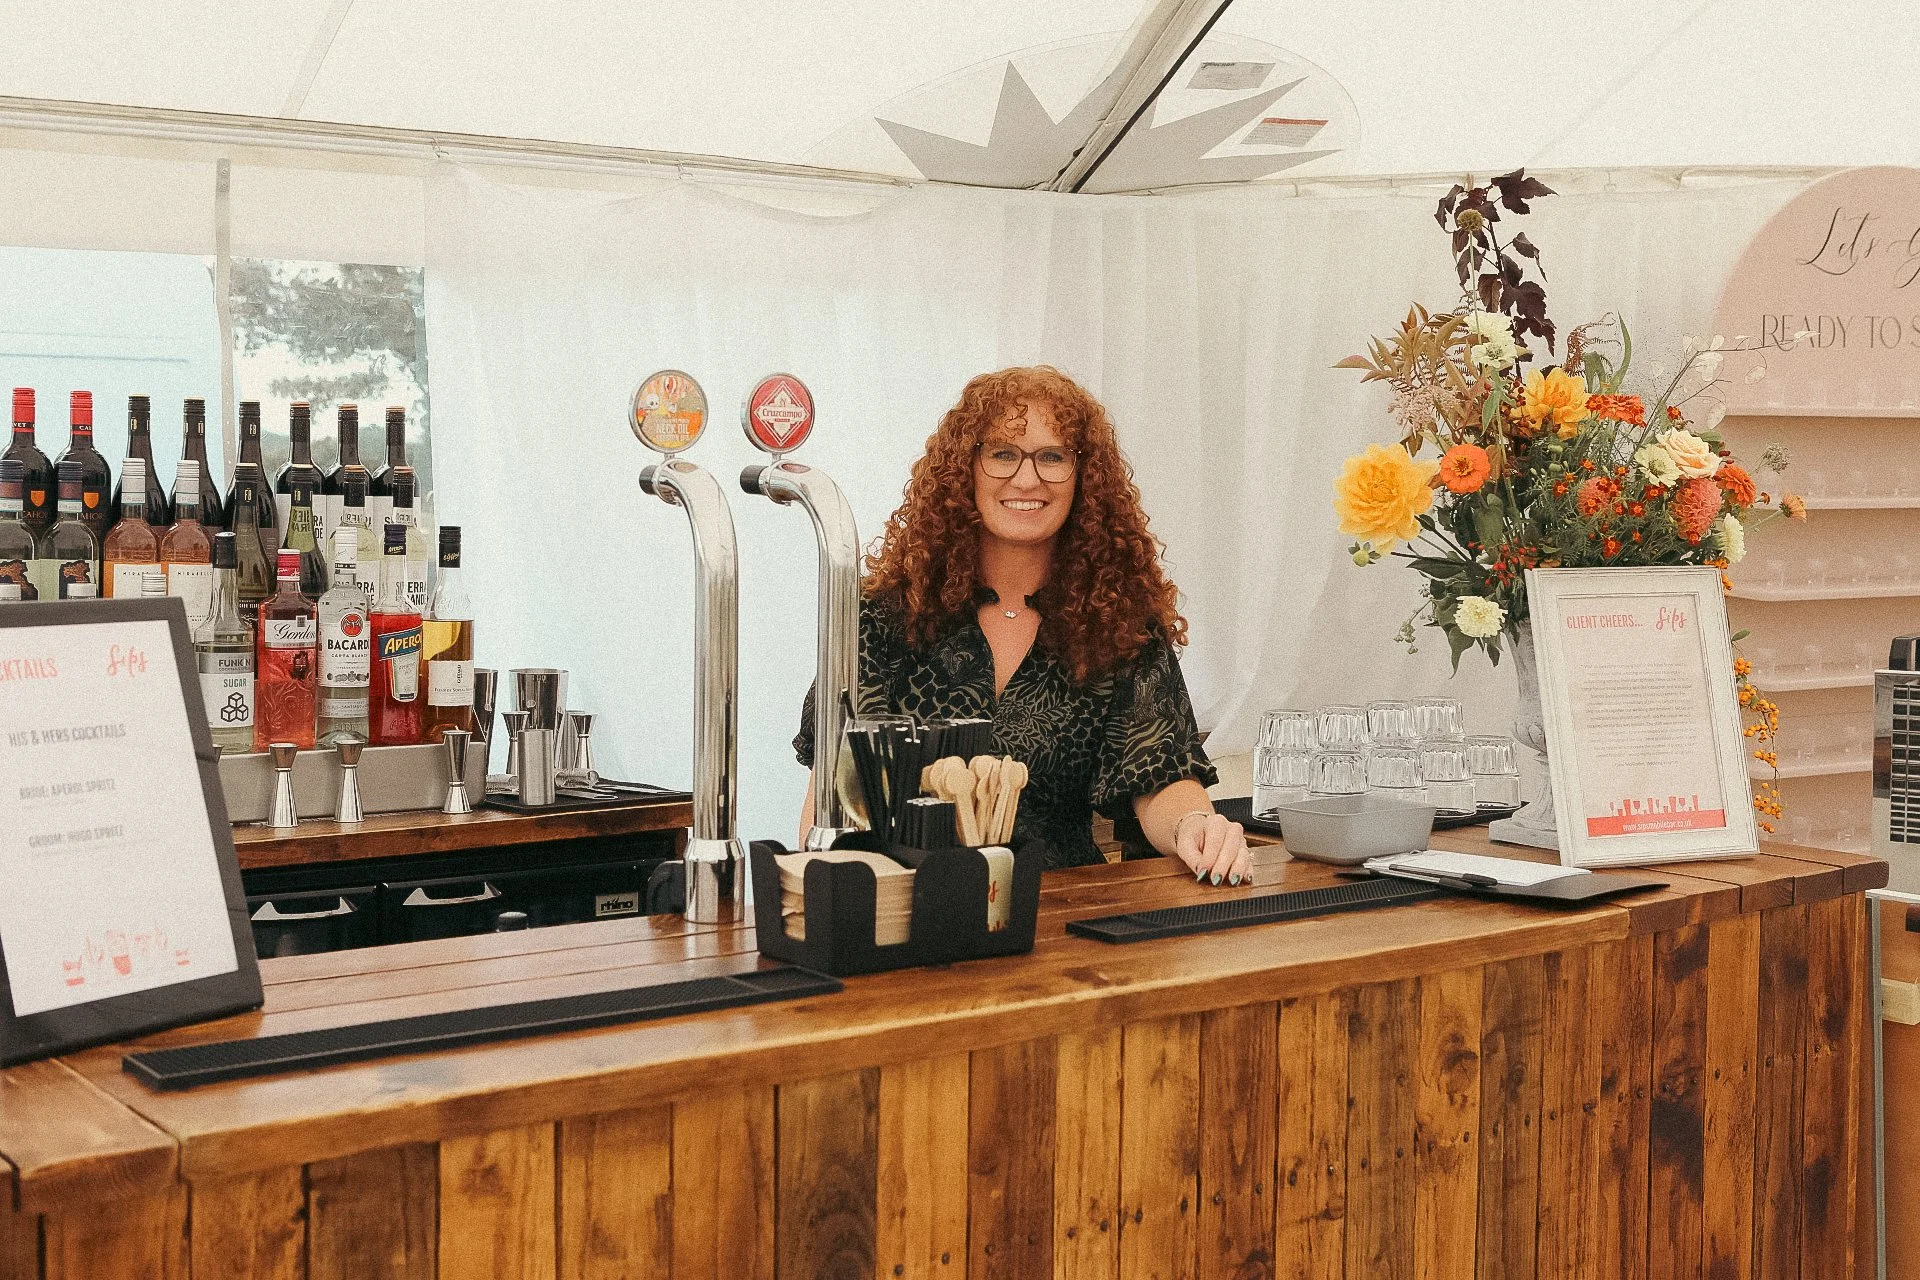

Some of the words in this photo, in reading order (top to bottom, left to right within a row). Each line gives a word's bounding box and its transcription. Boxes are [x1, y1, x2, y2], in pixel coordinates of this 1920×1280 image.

[1762, 314, 1852, 351] READY
[1864, 316, 1902, 349] TO
[762, 408, 803, 418] Cruzcampo
[1566, 616, 1598, 629] CLIENT
[223, 678, 247, 688] SUGAR
[8, 731, 29, 748] HIS
[42, 727, 71, 744] HERS
[71, 723, 127, 741] COCKTAILS
[600, 896, 634, 910] rhino
